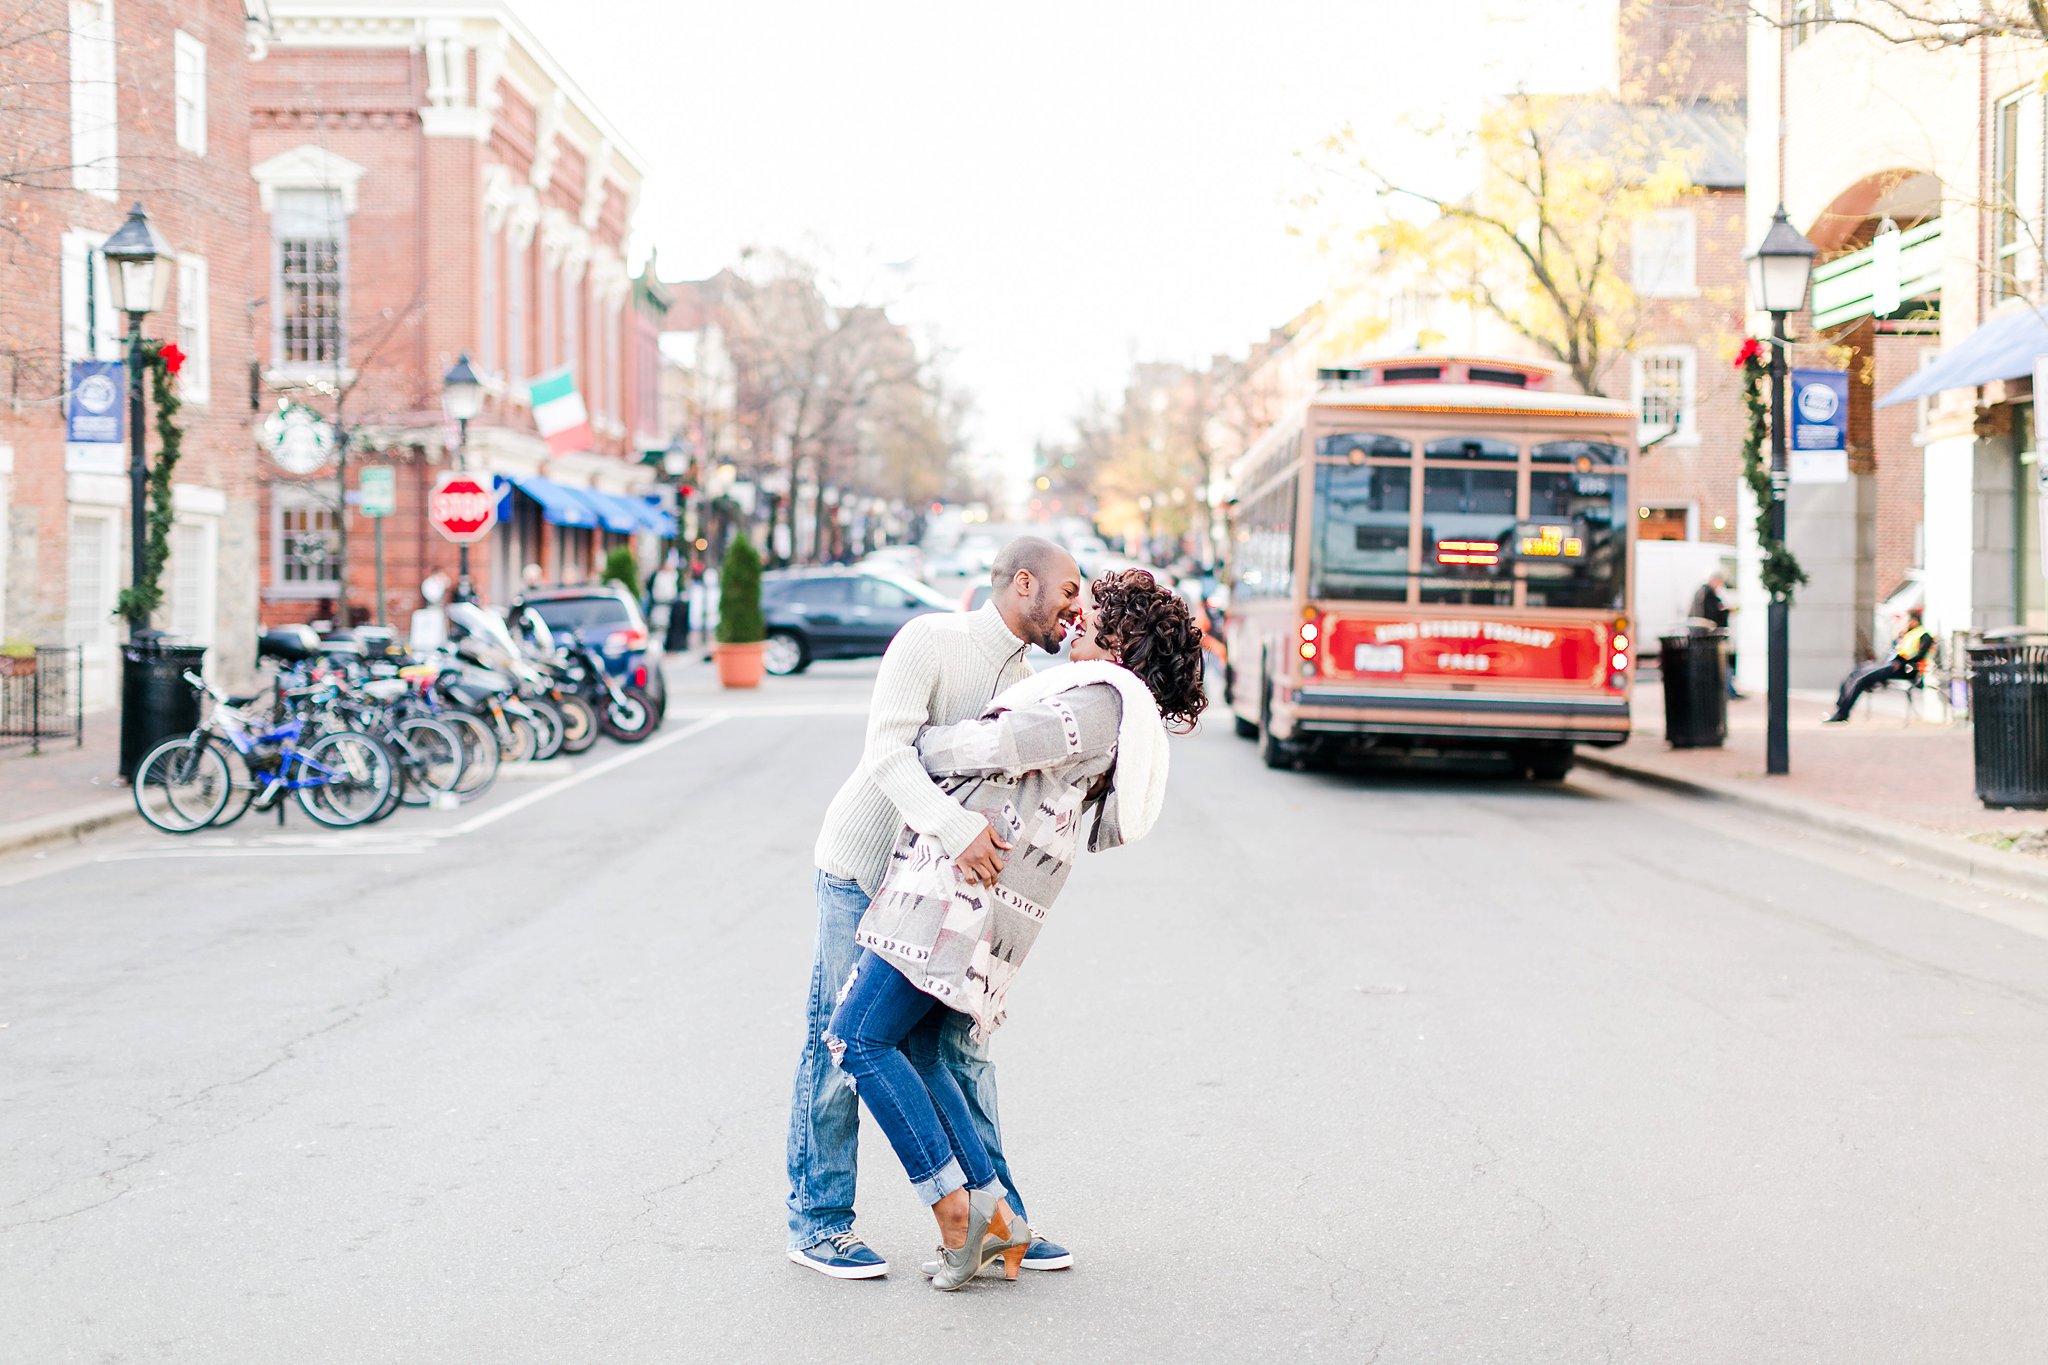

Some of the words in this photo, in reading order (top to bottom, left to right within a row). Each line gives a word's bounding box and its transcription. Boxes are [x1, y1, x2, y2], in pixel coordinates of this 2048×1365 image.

[434, 492, 488, 522] STOP
[1419, 620, 1481, 638] STREET
[1483, 622, 1555, 648] TROLLEY
[1438, 653, 1490, 671] FREE
